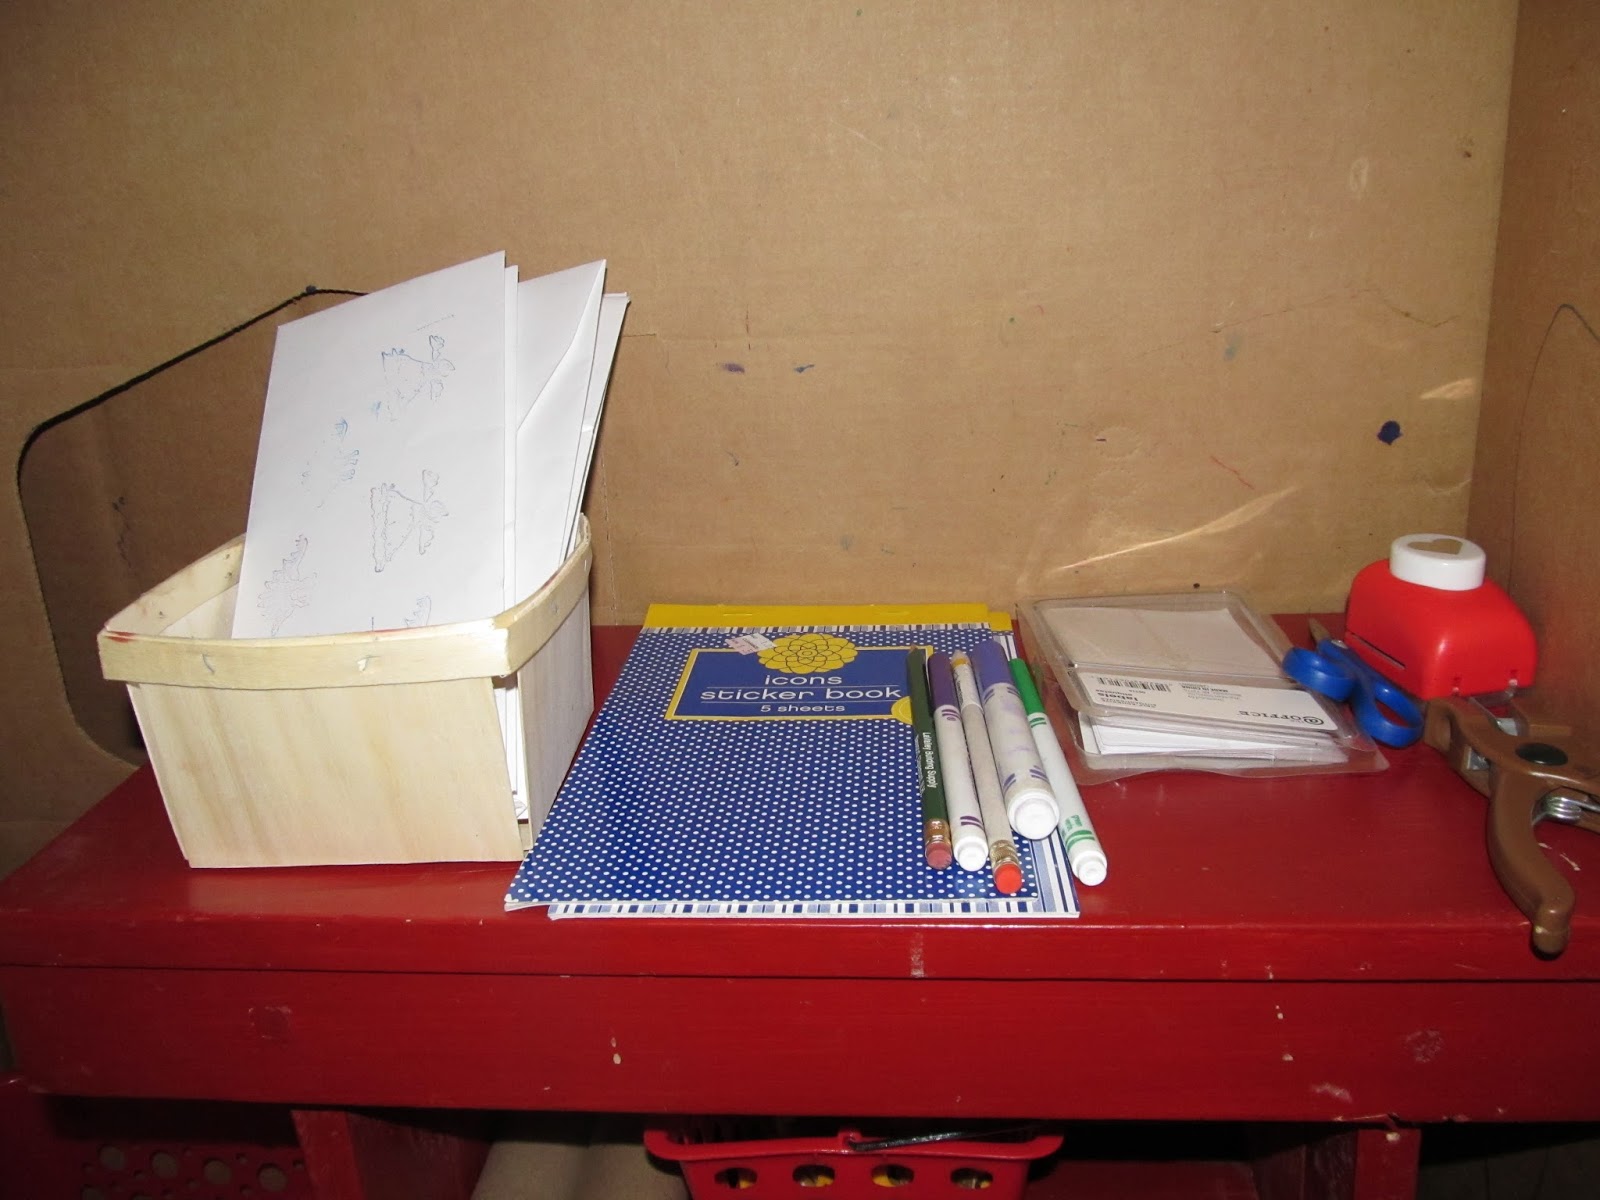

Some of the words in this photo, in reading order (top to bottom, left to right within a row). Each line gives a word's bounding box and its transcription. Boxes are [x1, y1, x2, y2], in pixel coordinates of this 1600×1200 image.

[764, 674, 842, 686] icons
[701, 687, 814, 701] sticker
[825, 686, 902, 700] book
[1097, 691, 1139, 702] labels
[760, 704, 771, 713] 5
[777, 703, 846, 713] sheets
[926, 770, 938, 788] Supply
